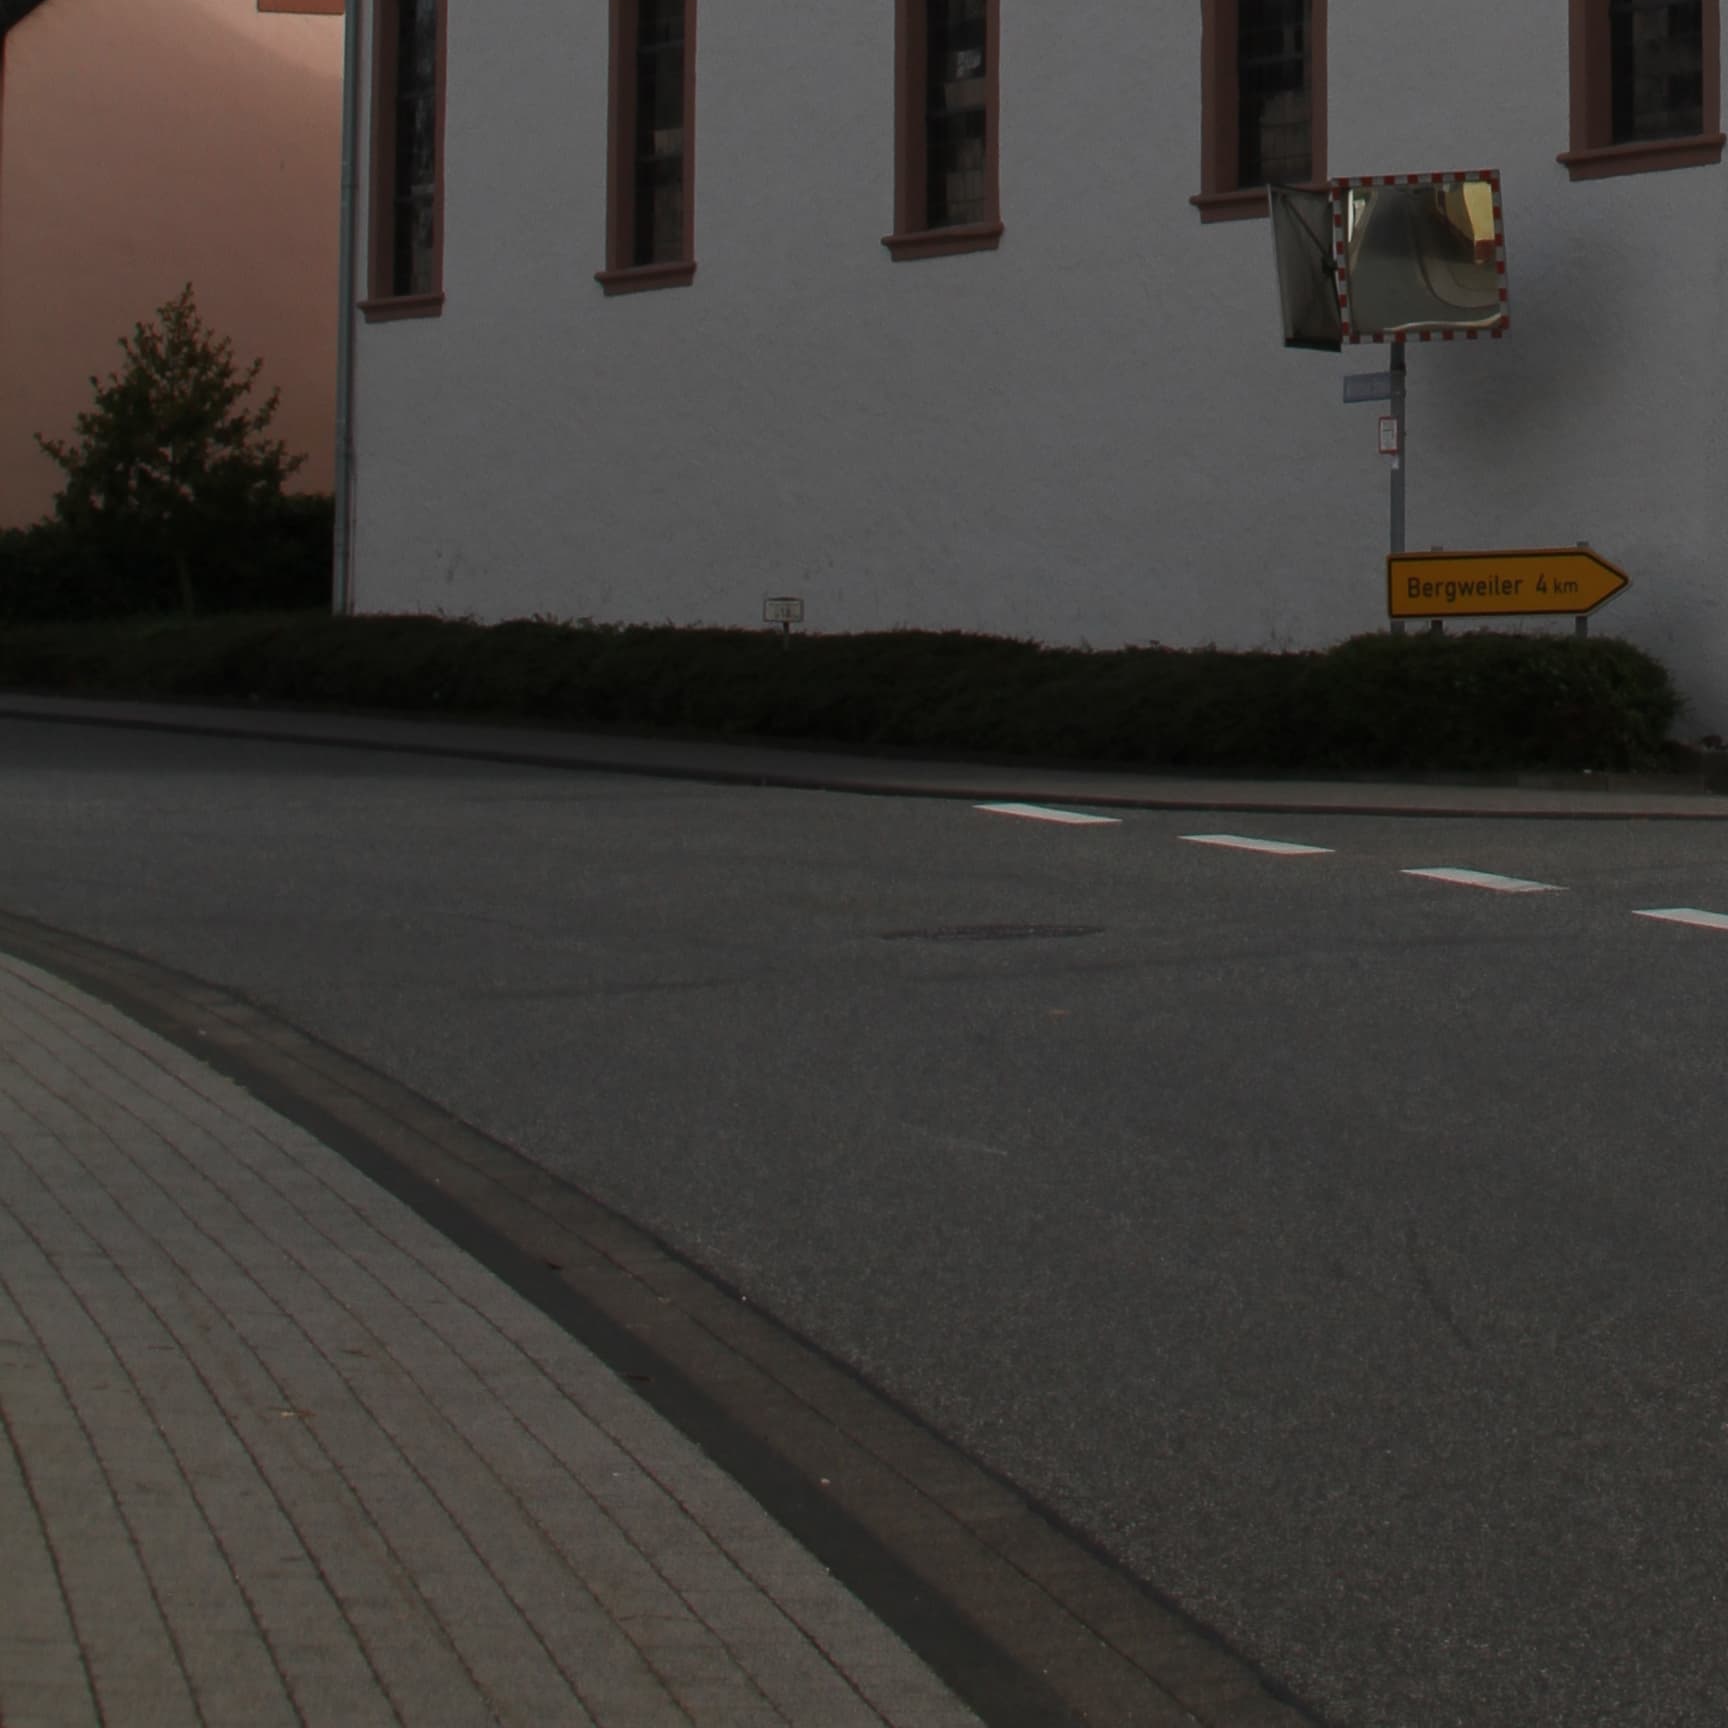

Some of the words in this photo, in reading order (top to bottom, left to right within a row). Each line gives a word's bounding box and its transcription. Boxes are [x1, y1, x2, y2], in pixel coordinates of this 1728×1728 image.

[1407, 576, 1523, 603] Bergweiler
[1535, 574, 1547, 593] 4
[1553, 578, 1578, 593] km
